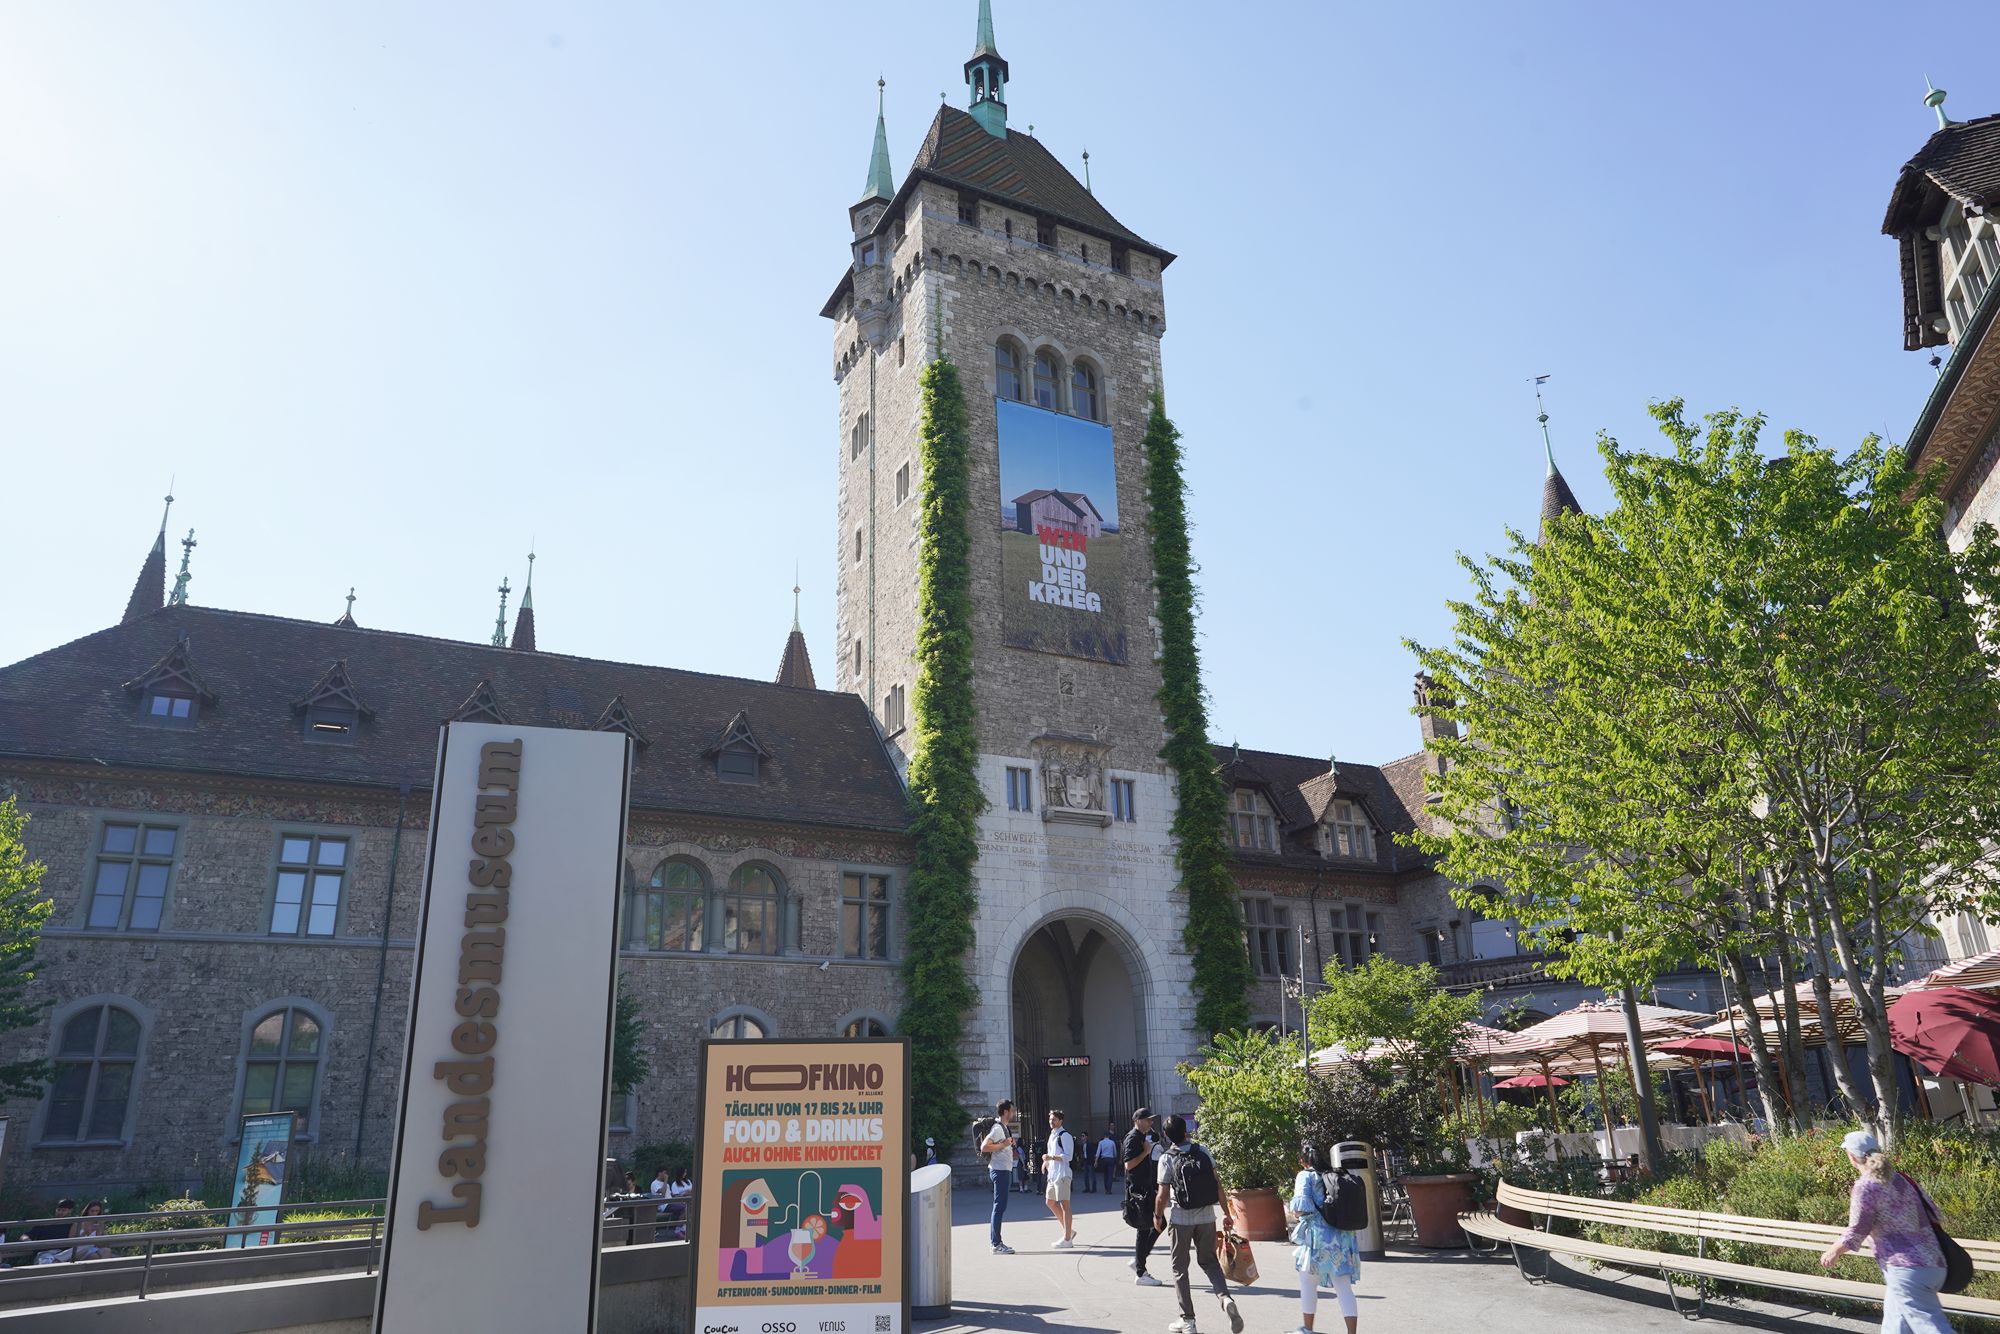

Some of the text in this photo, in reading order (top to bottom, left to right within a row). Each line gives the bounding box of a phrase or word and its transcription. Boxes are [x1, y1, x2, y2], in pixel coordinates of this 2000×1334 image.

[1036, 524, 1087, 553] WIR
[1039, 544, 1087, 571] UND
[1042, 564, 1087, 590] DER
[1028, 581, 1101, 613] KRIEG
[417, 738, 523, 1231] Landesmuseum
[725, 1063, 884, 1092] HOFKINO
[725, 1100, 884, 1117] TÄGLICH VON 17 BIS 24 UHR
[723, 1118, 884, 1144] FOOD & DRINKS
[723, 1145, 883, 1163] AUCH OHNE KINOTICKET
[761, 1322, 797, 1333] OSSO
